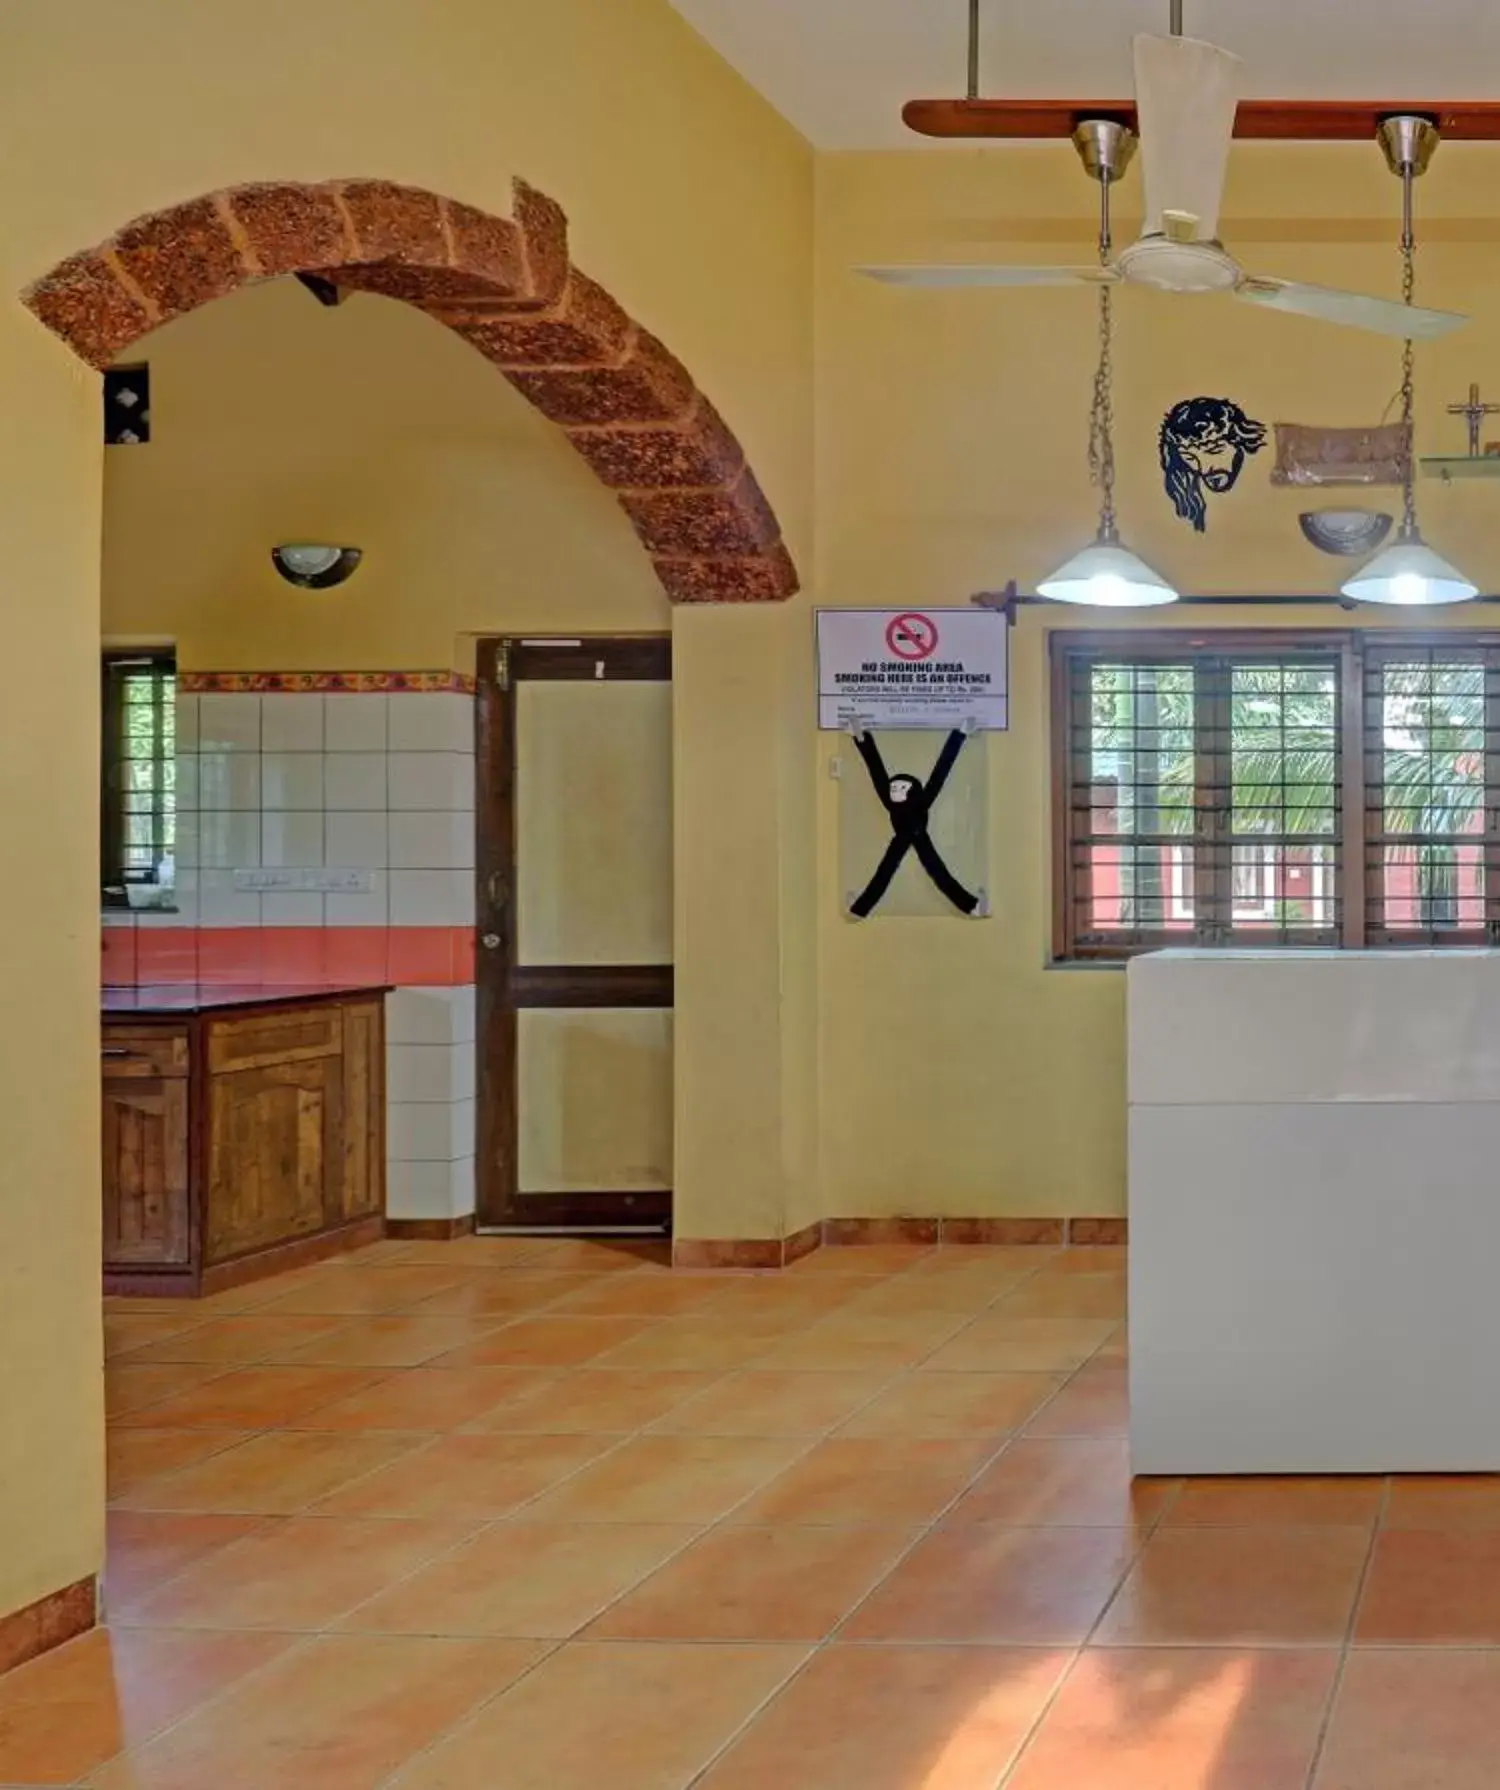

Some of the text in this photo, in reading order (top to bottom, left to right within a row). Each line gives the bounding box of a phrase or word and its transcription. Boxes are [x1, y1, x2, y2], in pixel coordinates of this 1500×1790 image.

[861, 662, 965, 673] NO SMOKING AREA
[834, 673, 991, 684] SMOKING HERE IS AN OFFENCE
